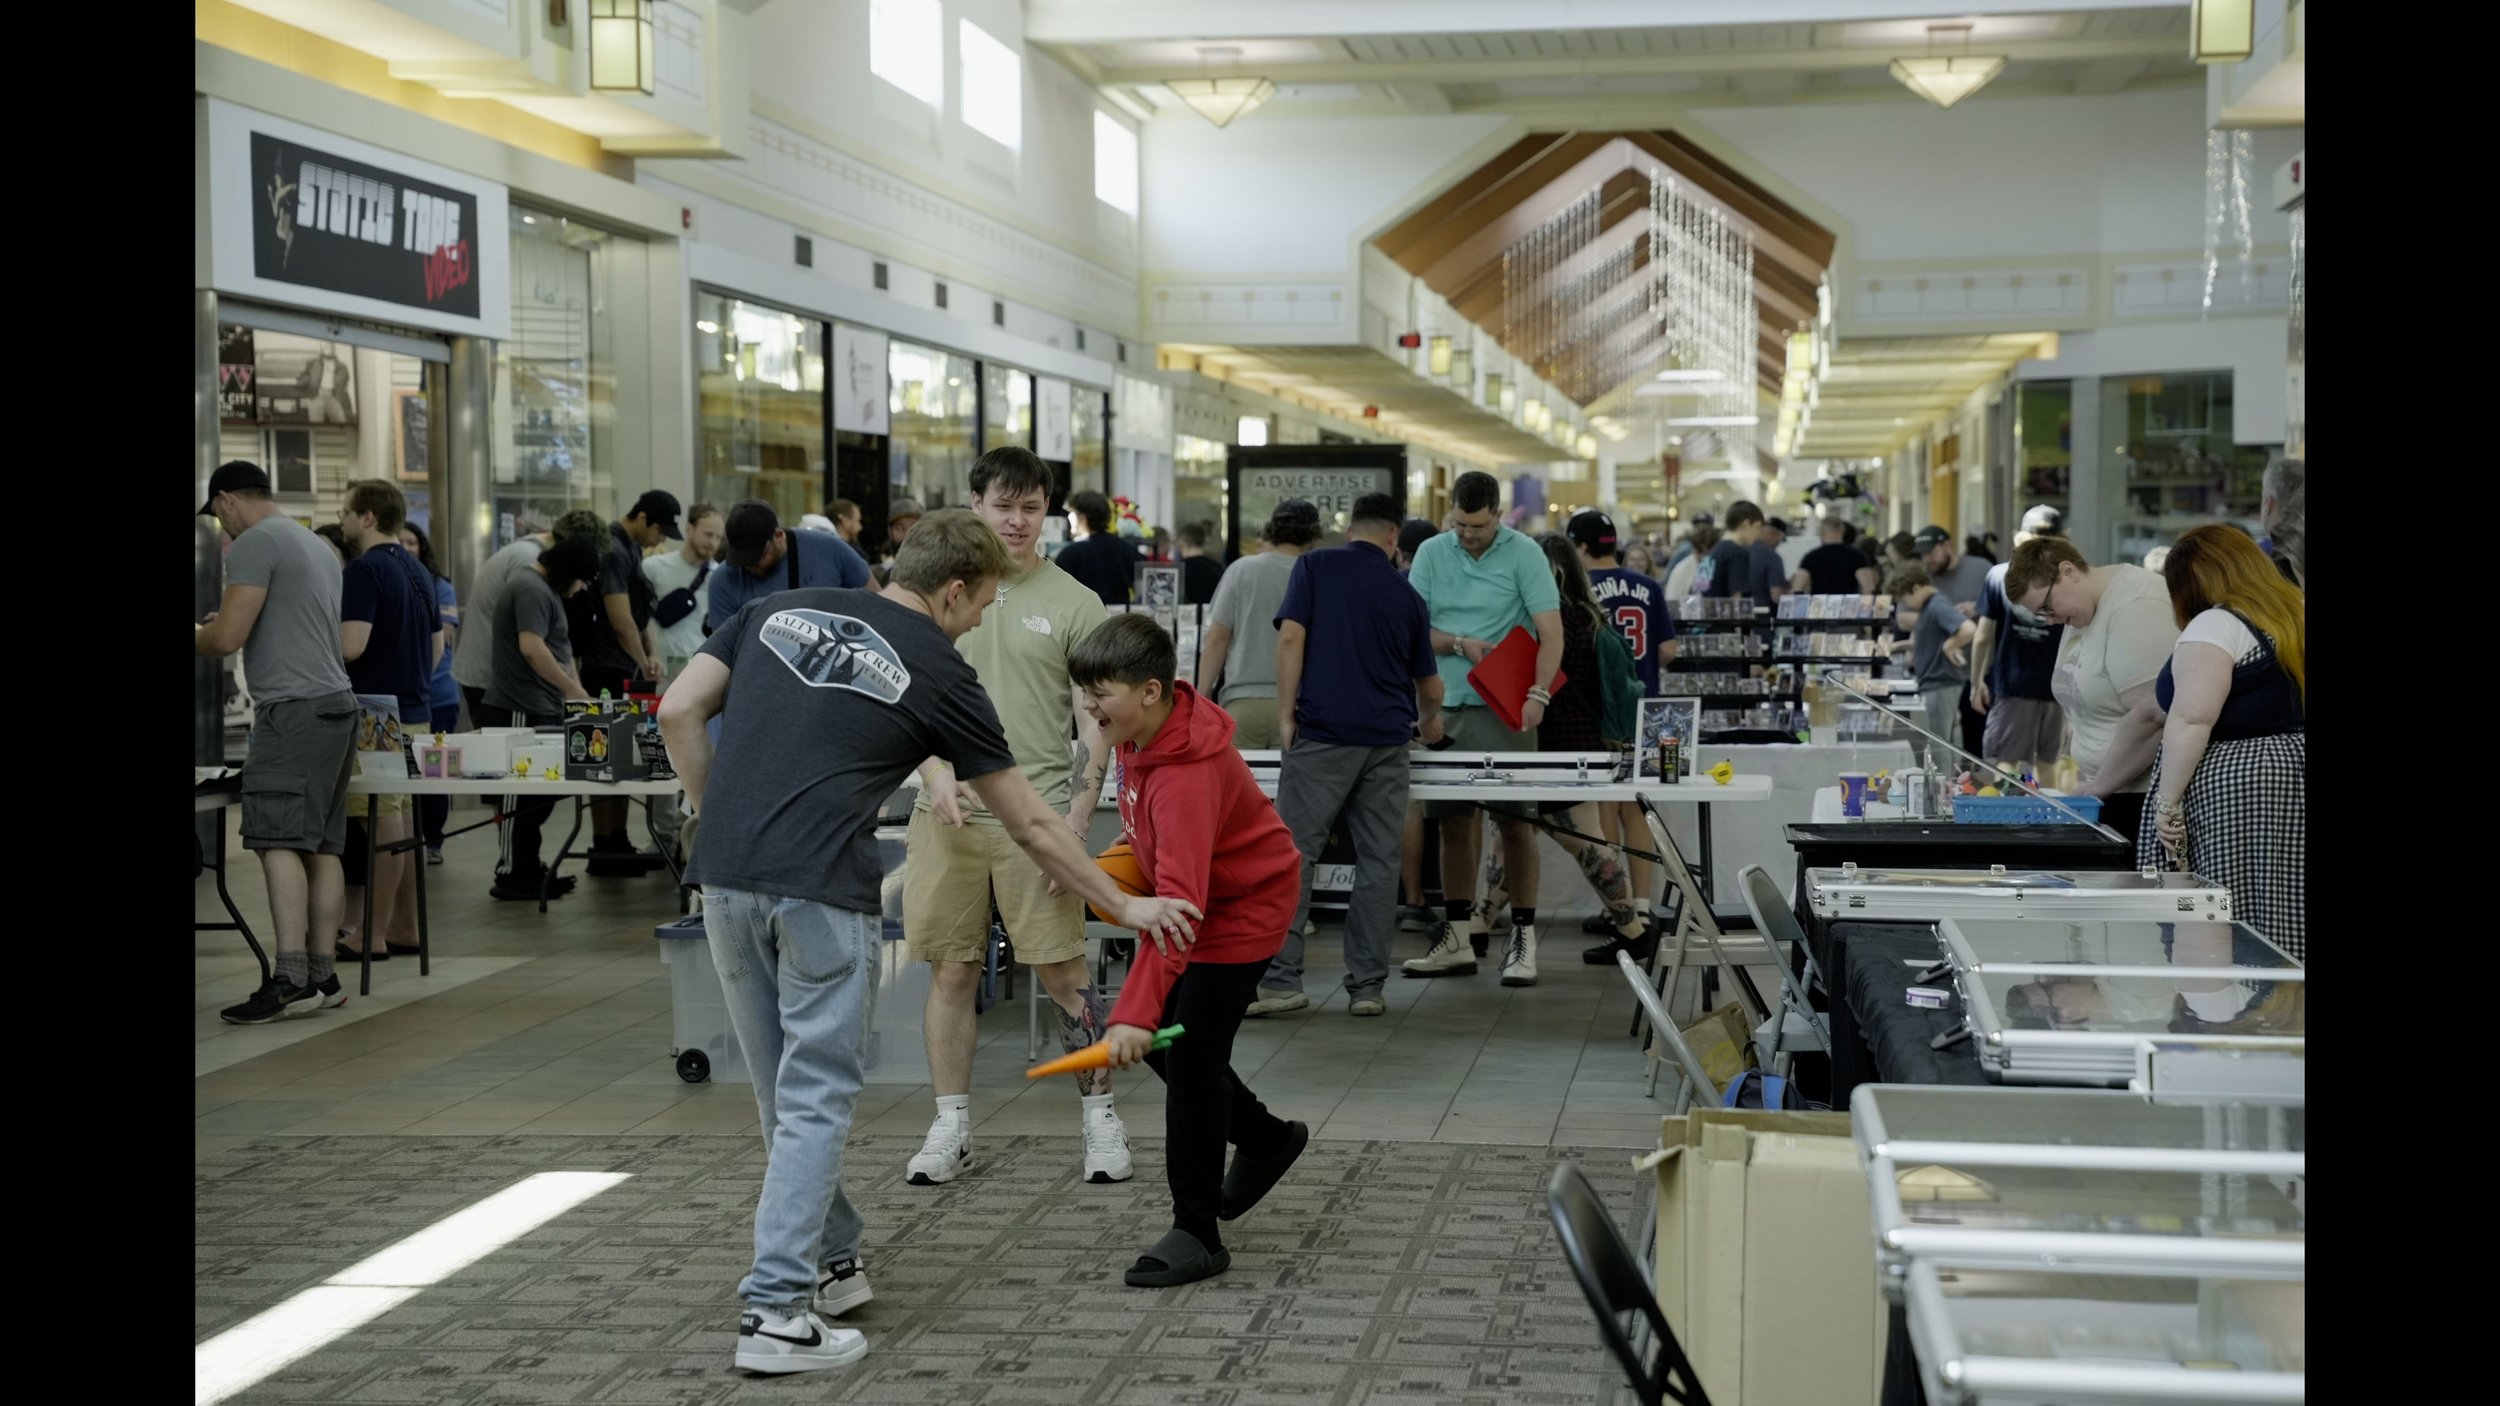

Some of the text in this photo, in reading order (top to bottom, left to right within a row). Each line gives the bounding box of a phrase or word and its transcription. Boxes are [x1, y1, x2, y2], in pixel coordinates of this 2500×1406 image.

[297, 160, 461, 261] STATIC TAPE
[423, 239, 471, 304] VIDEO
[1254, 474, 1374, 489] ADVERTISE
[1592, 576, 1629, 602] CUÑA
[766, 627, 888, 689] CHASING TAIL
[771, 615, 906, 684] SALTY CREW
[1602, 606, 1647, 660] 3
[1641, 747, 1691, 760] CRUER
[835, 1260, 852, 1272] NIKE
